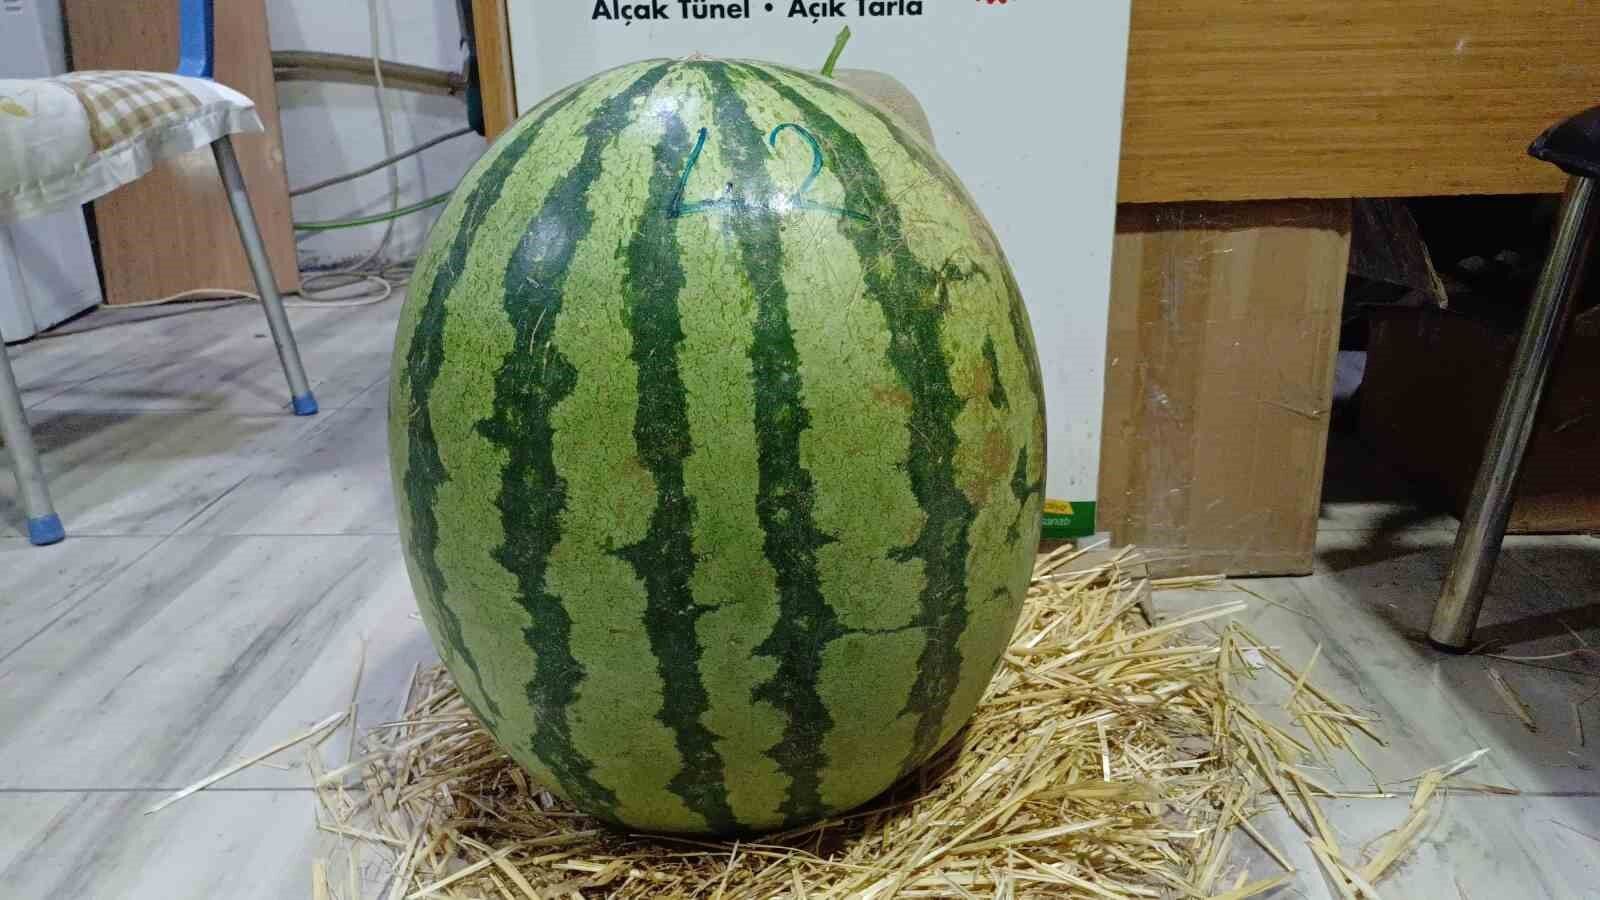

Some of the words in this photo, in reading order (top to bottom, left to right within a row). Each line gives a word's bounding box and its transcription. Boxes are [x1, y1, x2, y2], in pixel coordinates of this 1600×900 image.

[591, 0, 670, 26] Alçak
[678, 0, 750, 20] Tünel
[787, 0, 846, 24] Açık
[856, 0, 923, 17] Tarla
